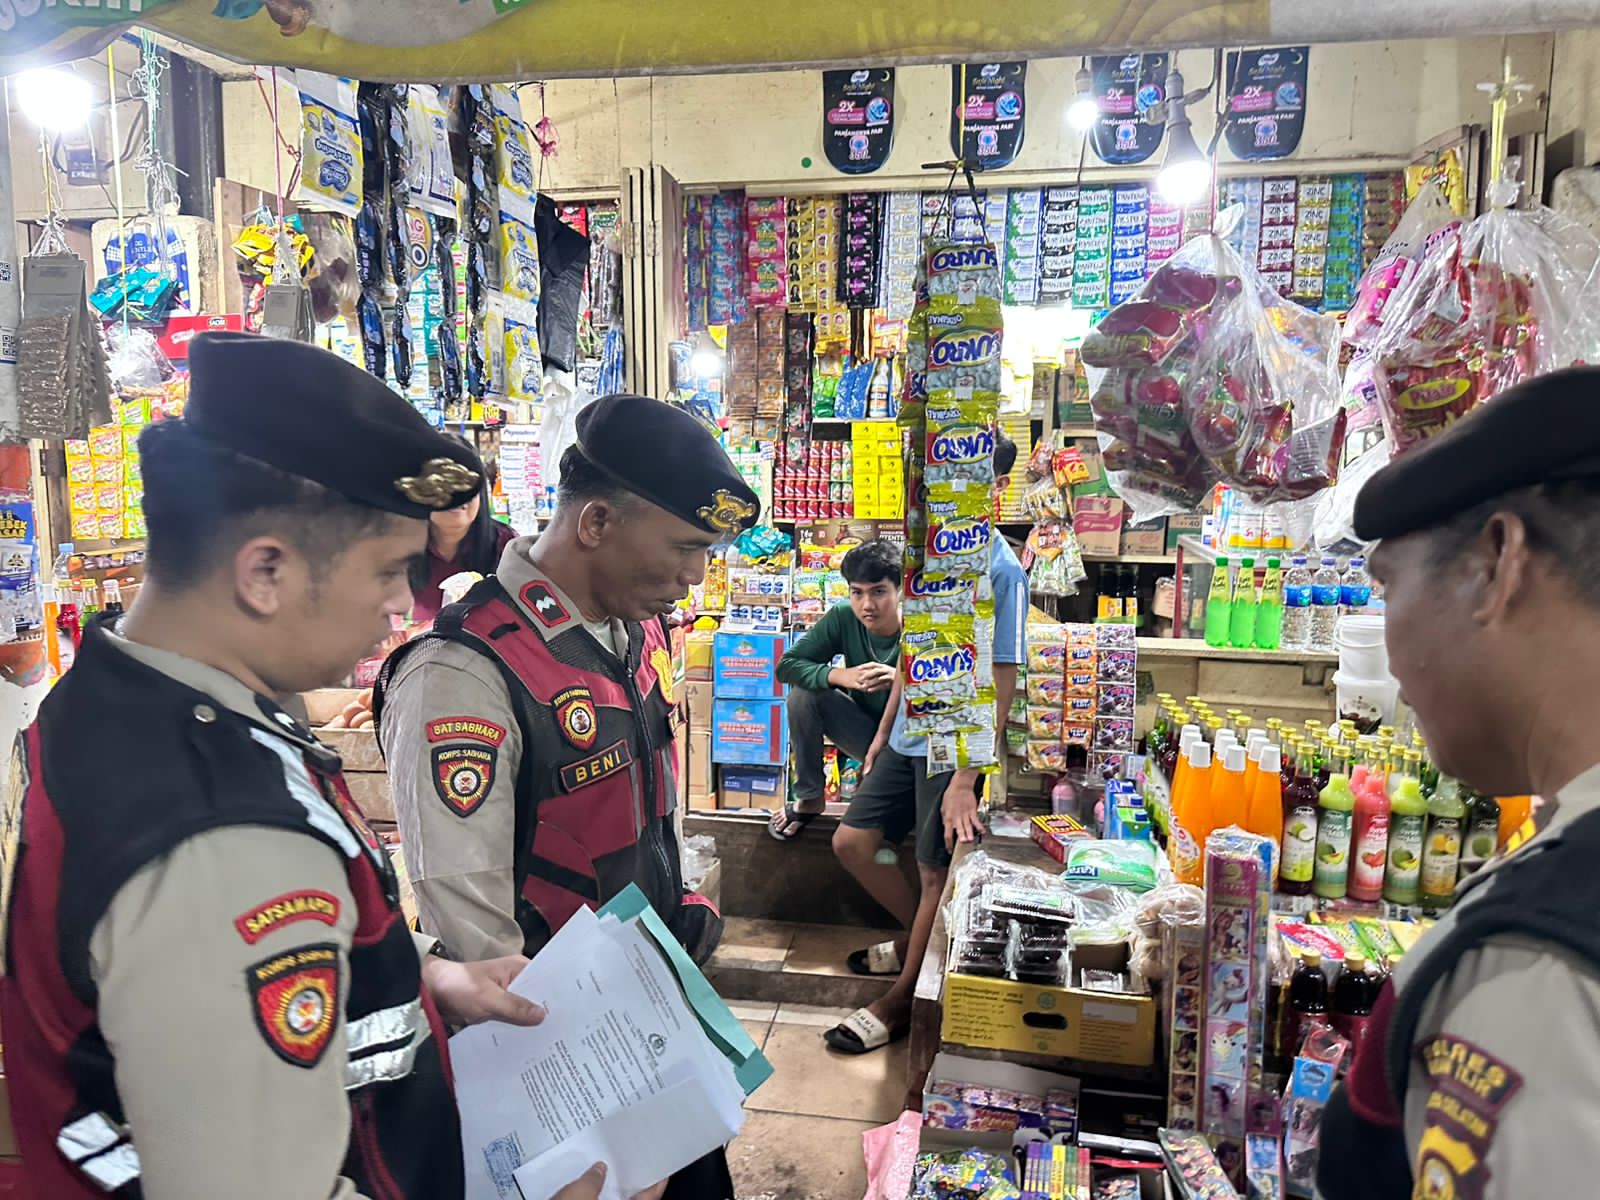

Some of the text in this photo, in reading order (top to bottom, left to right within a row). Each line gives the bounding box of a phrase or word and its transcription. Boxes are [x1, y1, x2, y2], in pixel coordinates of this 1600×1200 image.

[1106, 87, 1124, 101] 2X
[1243, 84, 1263, 98] 2X
[838, 99, 855, 113] 2X
[967, 94, 985, 108] 2X
[1270, 183, 1289, 192] ZINC
[1306, 187, 1325, 196] ZINC
[1269, 205, 1288, 214] ZINC
[1304, 210, 1324, 219] ZINC
[1268, 229, 1288, 237] ZINC
[1302, 233, 1322, 242] ZINC
[1267, 252, 1287, 261] ZINC
[1300, 256, 1319, 265] ZINC
[1266, 274, 1286, 283] ZINC
[1298, 279, 1318, 288] ZINC
[934, 519, 990, 555] SUKRO
[911, 648, 974, 681] SUKRO
[433, 722, 500, 741] SAT SABHARA
[438, 750, 462, 762] KORPS
[575, 749, 621, 783] BENI
[1068, 865, 1098, 877] kara
